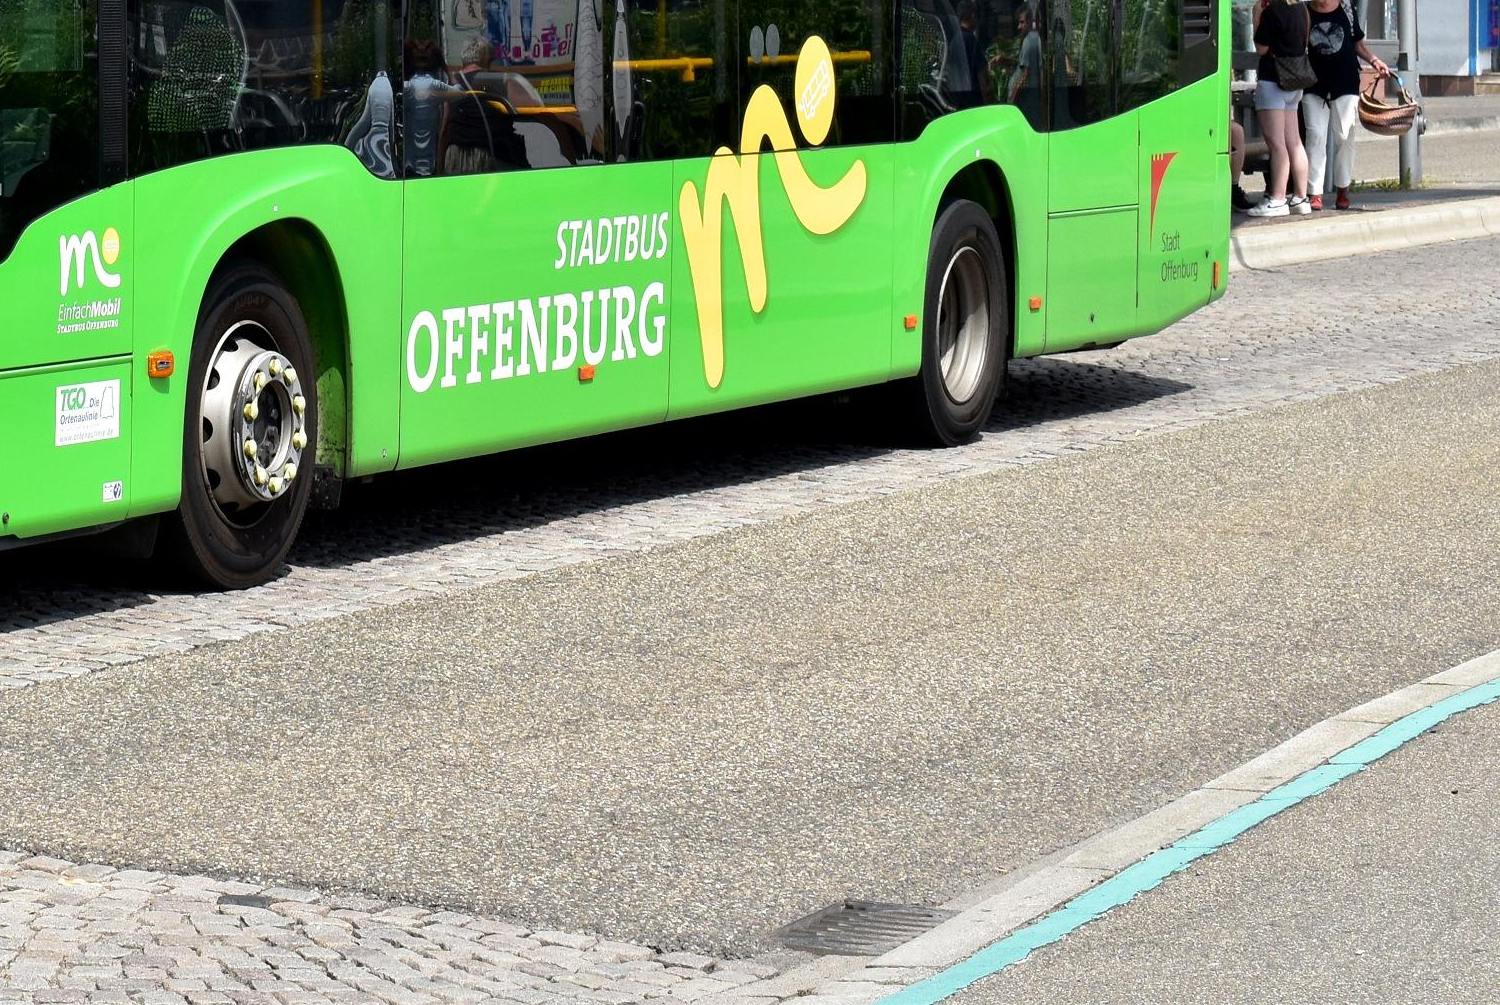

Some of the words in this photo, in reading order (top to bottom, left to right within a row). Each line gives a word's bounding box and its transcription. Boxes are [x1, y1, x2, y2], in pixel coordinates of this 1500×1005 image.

[554, 211, 669, 269] STADTBUS
[1161, 231, 1180, 253] Stadt
[1161, 260, 1198, 282] Offenburg
[406, 282, 666, 393] OFFENBURG
[60, 387, 86, 411] TGO
[89, 397, 100, 408] Die
[60, 411, 99, 425] Ortenaulinie
